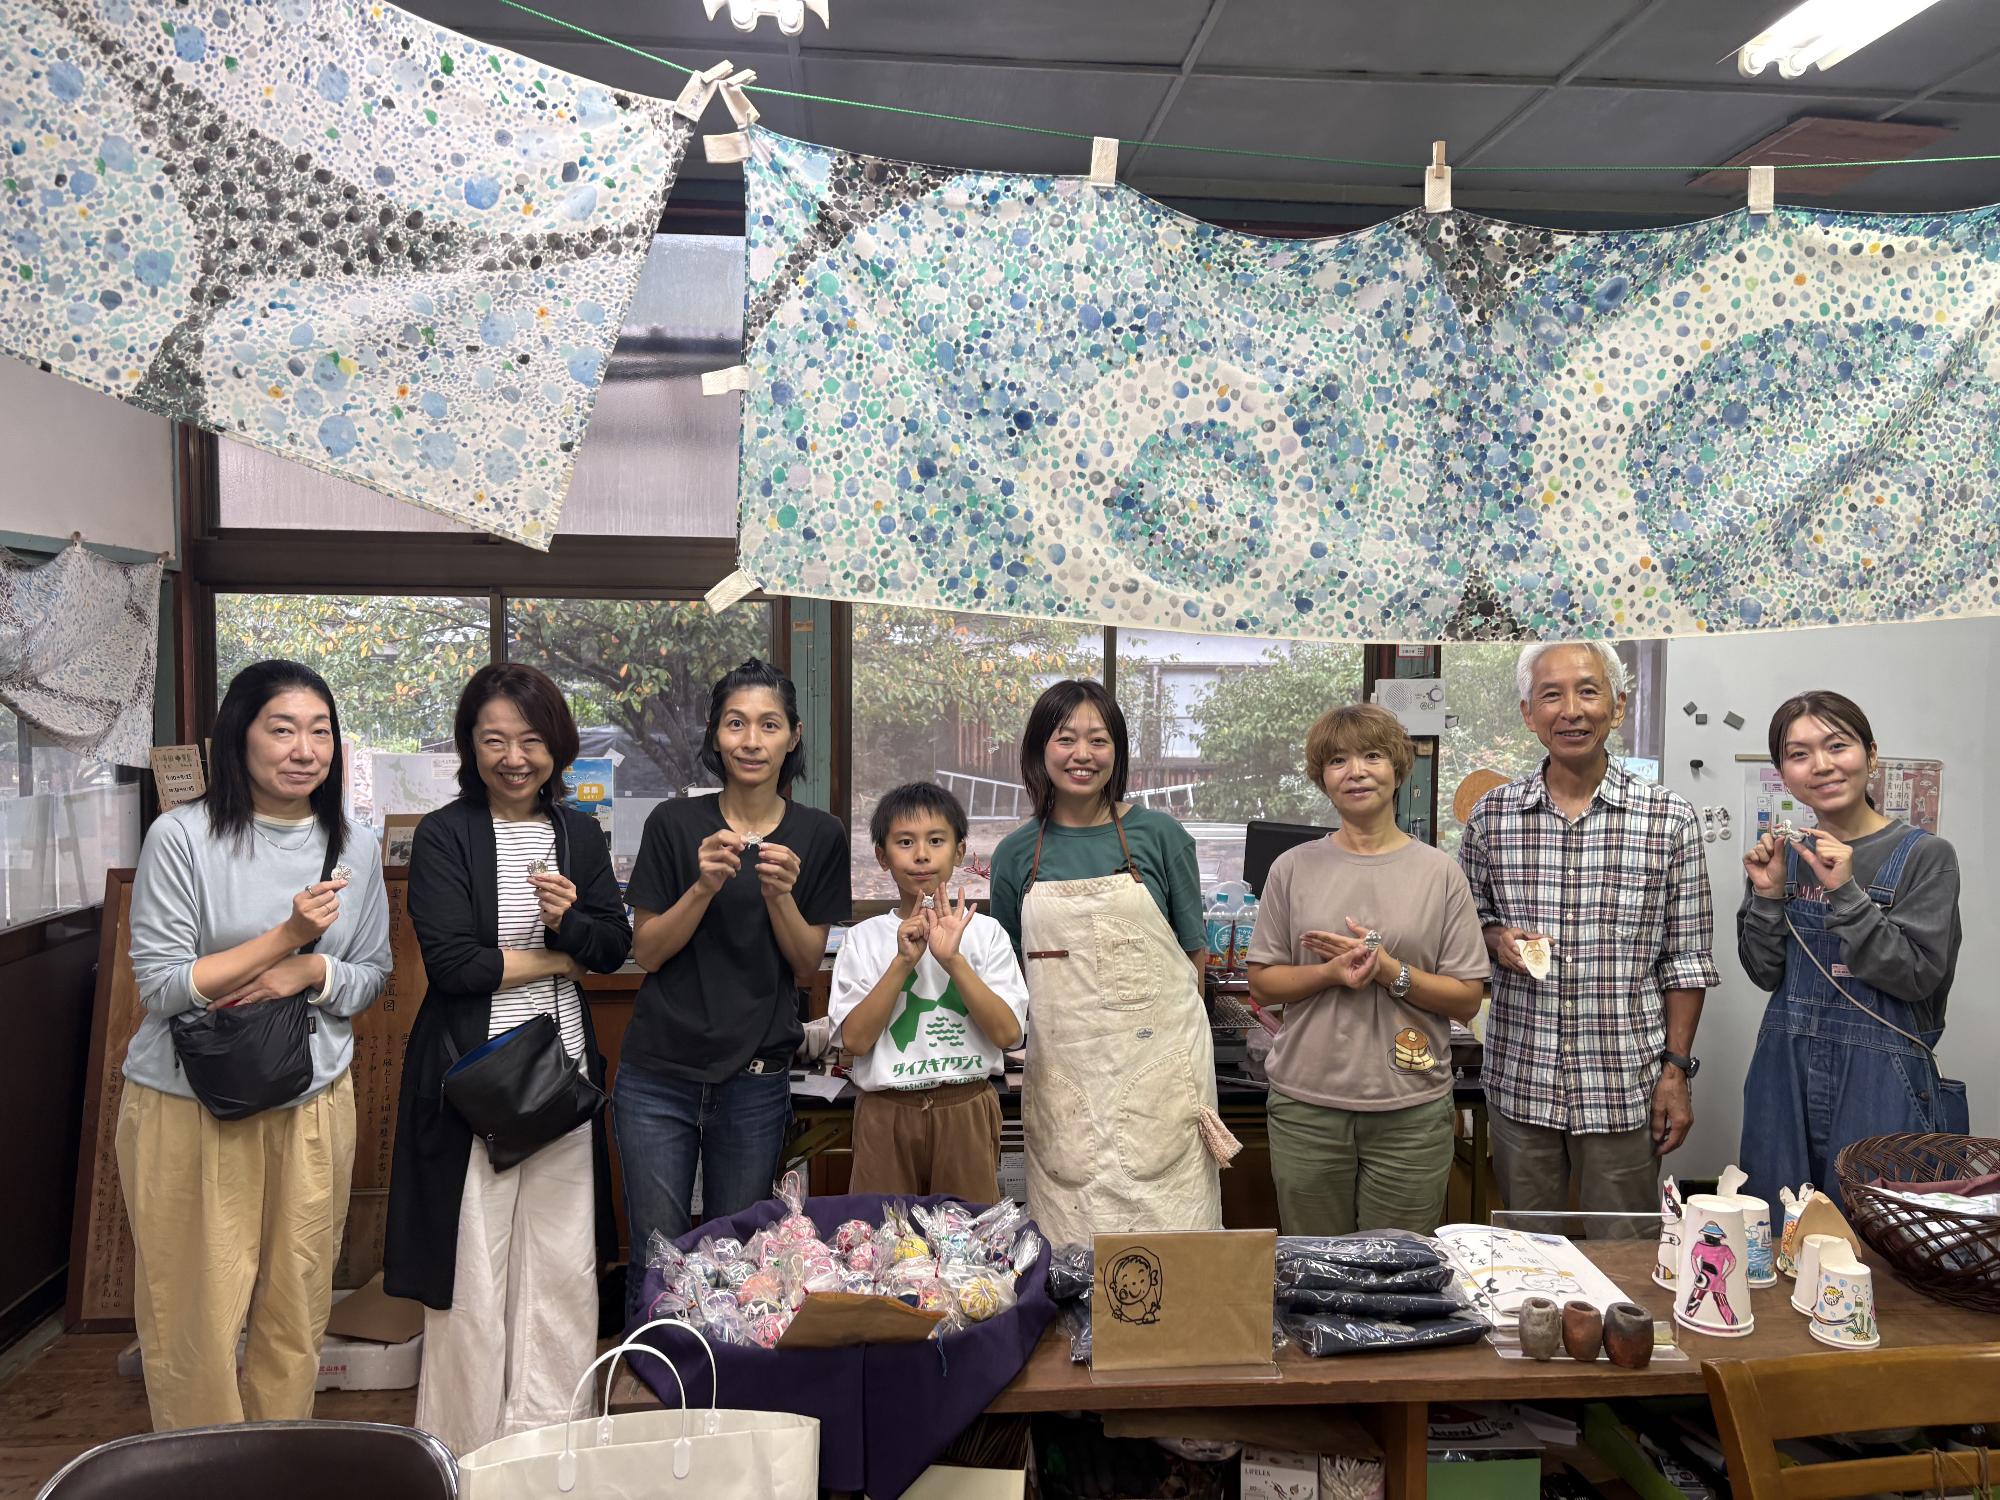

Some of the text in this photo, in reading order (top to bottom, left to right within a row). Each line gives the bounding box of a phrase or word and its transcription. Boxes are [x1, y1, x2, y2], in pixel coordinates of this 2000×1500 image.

[893, 1055, 983, 1077] ダイスキアワシマ
[893, 1080, 936, 1091] WASHIMA
